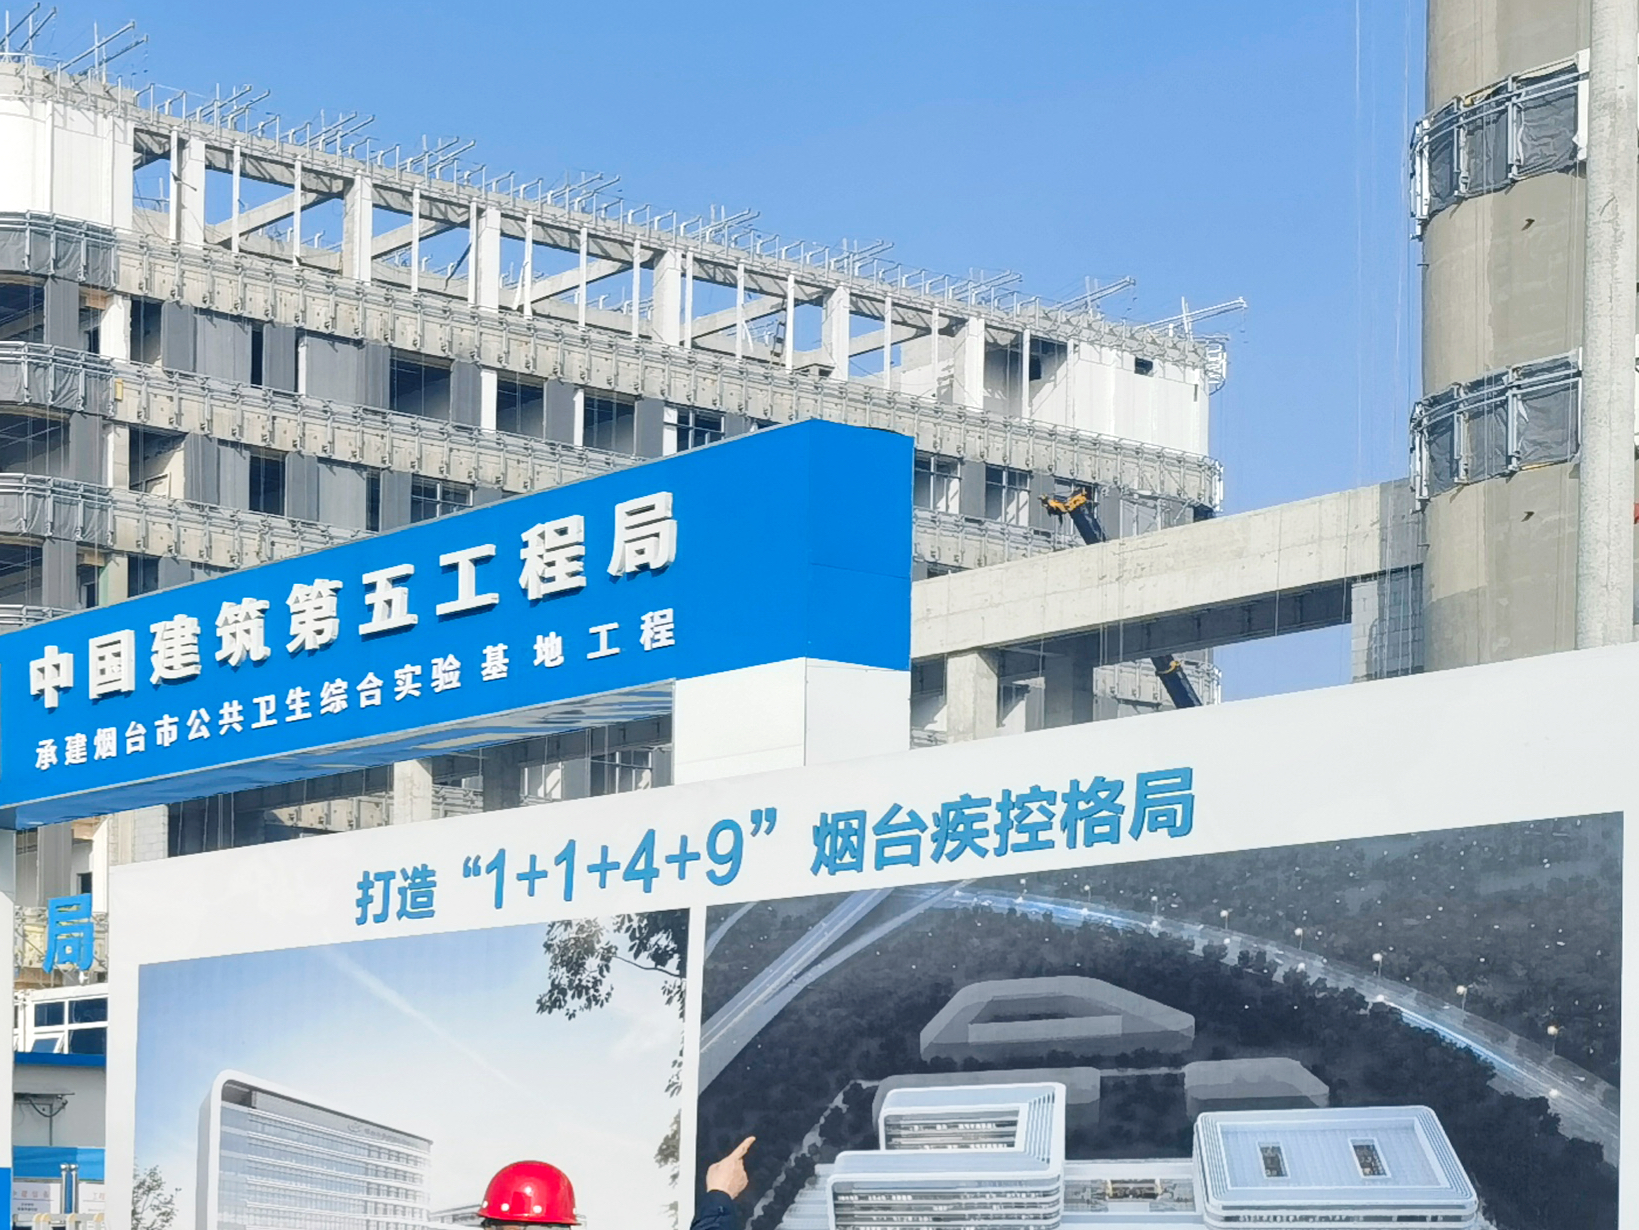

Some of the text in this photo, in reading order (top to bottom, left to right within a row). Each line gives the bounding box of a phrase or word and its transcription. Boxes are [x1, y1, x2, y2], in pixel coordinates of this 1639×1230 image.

[29, 491, 678, 710] 中国建筑第五工程局
[34, 609, 676, 771] 承建烟台市公共卫生综合实验基地工程
[43, 892, 95, 974] 局
